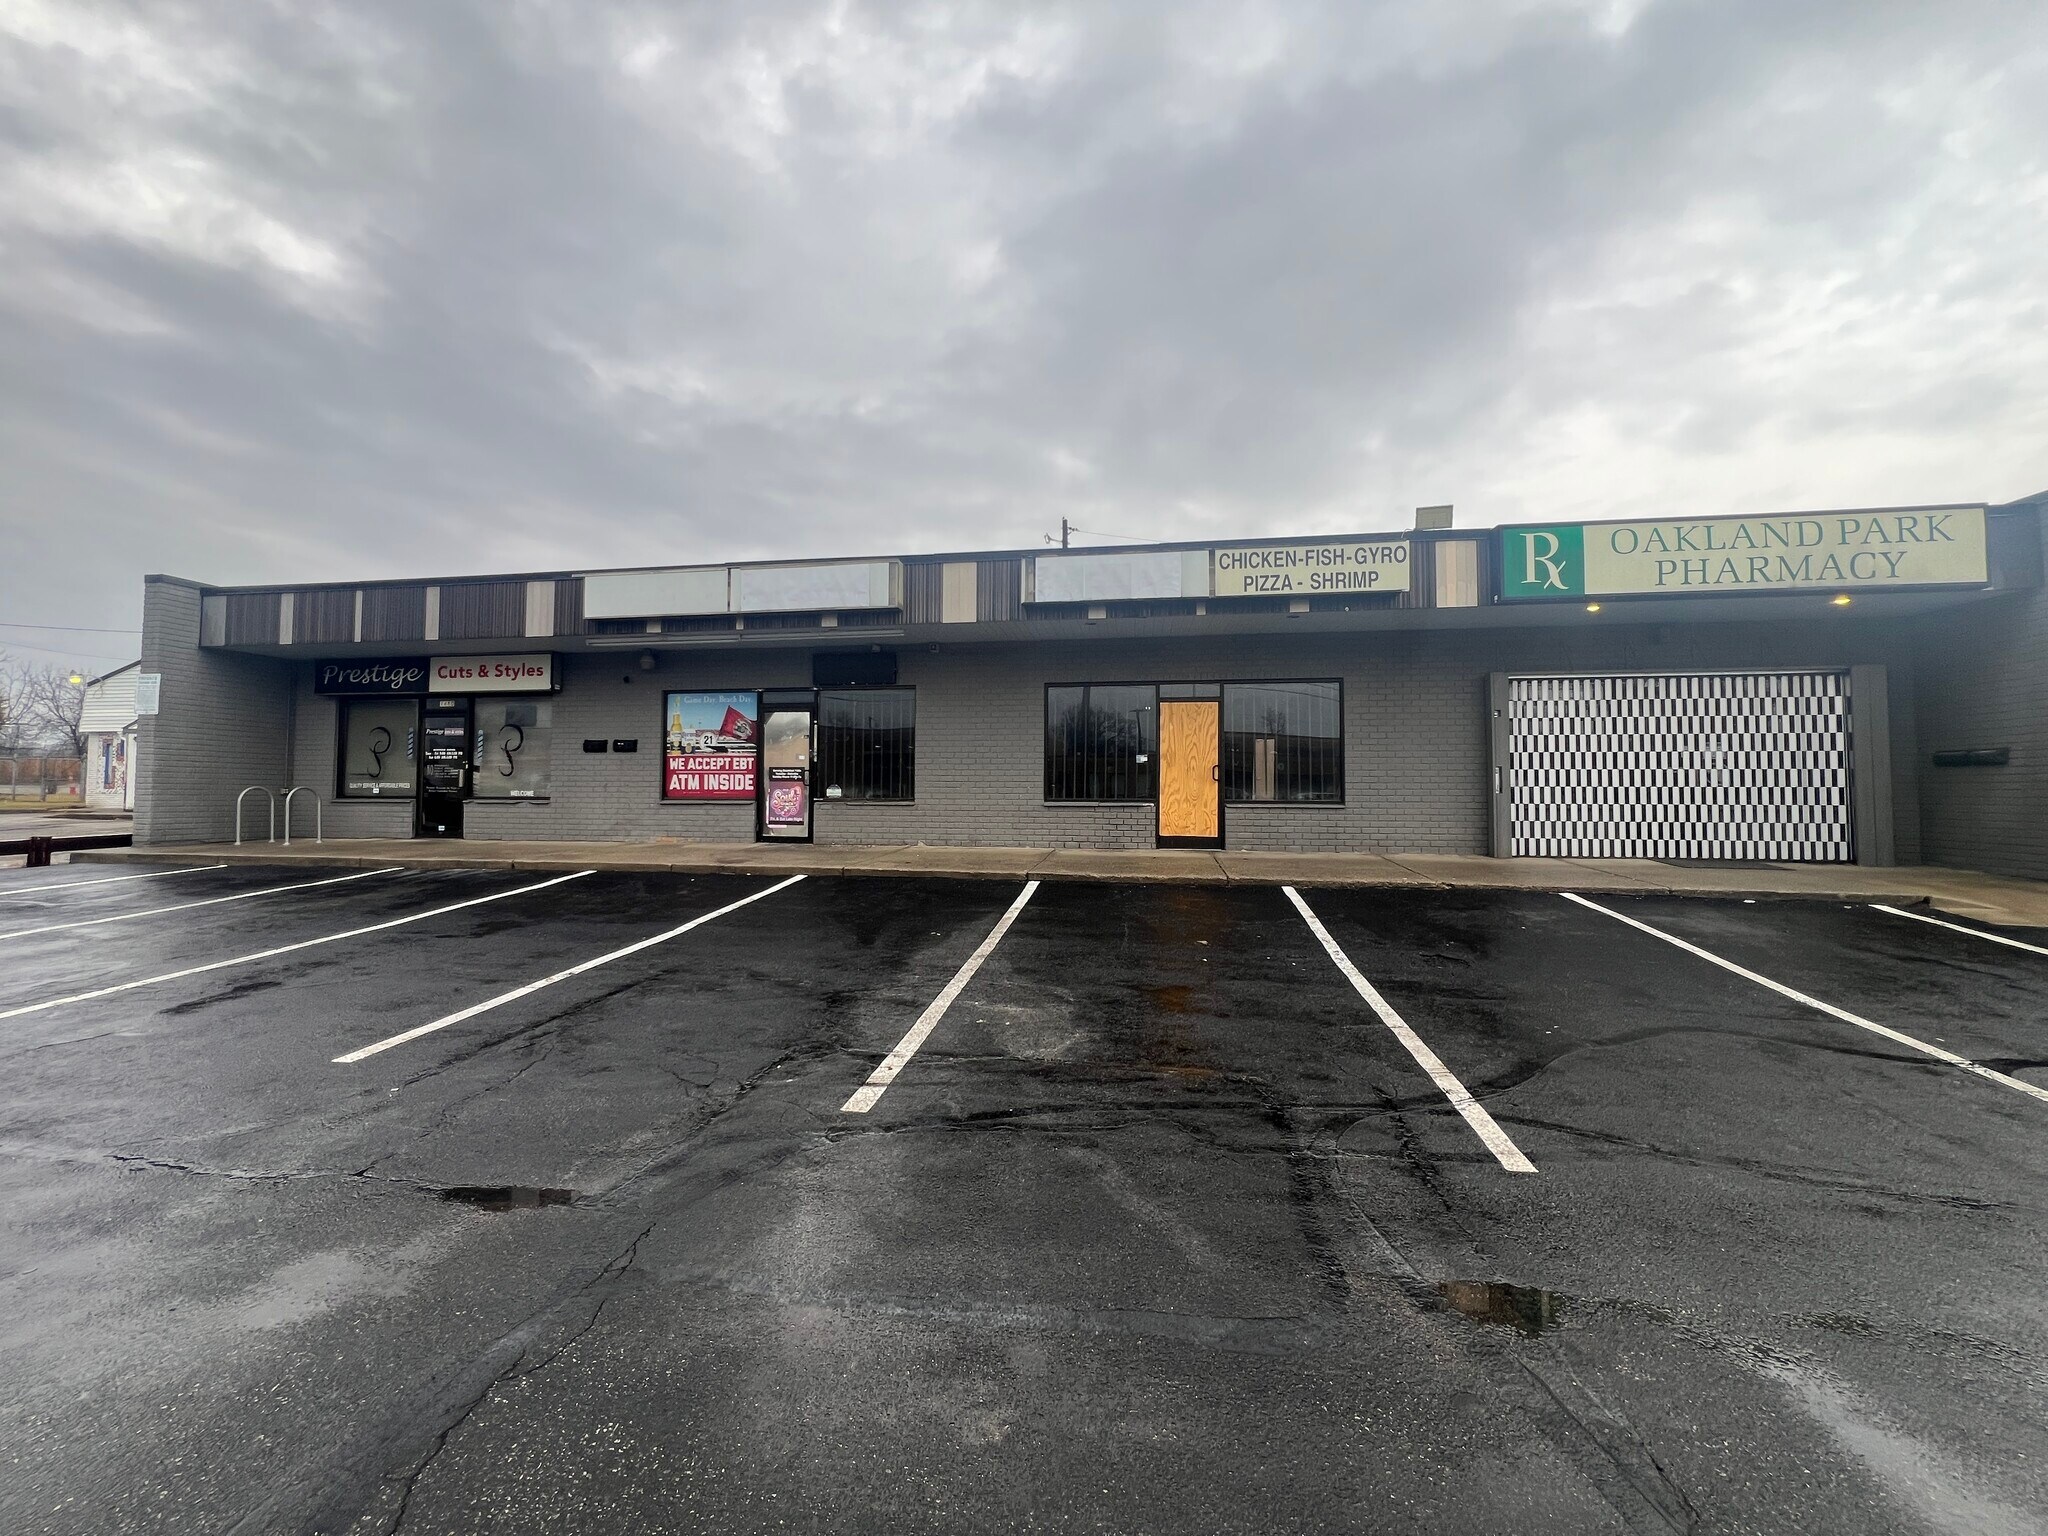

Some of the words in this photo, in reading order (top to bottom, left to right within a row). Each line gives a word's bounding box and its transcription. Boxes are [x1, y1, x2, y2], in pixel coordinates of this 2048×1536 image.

[1610, 520, 1824, 555] OAKLAND
[1837, 514, 1955, 545] PARK
[1219, 545, 1407, 570] CHICKEN-FISH-GYRO
[1654, 551, 1908, 586] PHARMACY
[1244, 574, 1293, 592] PIZZA
[1310, 571, 1379, 590] SHRIMP
[323, 664, 424, 688] Prestige
[437, 665, 473, 679] Cuts
[478, 665, 489, 678] &
[494, 663, 544, 681] Styles
[719, 695, 737, 703] Beach
[703, 735, 713, 745] 21
[669, 758, 685, 770] WE
[687, 758, 732, 770] ACCEPT
[733, 757, 754, 770] EBT
[669, 774, 700, 790] ATM
[703, 774, 754, 790] INSIDE
